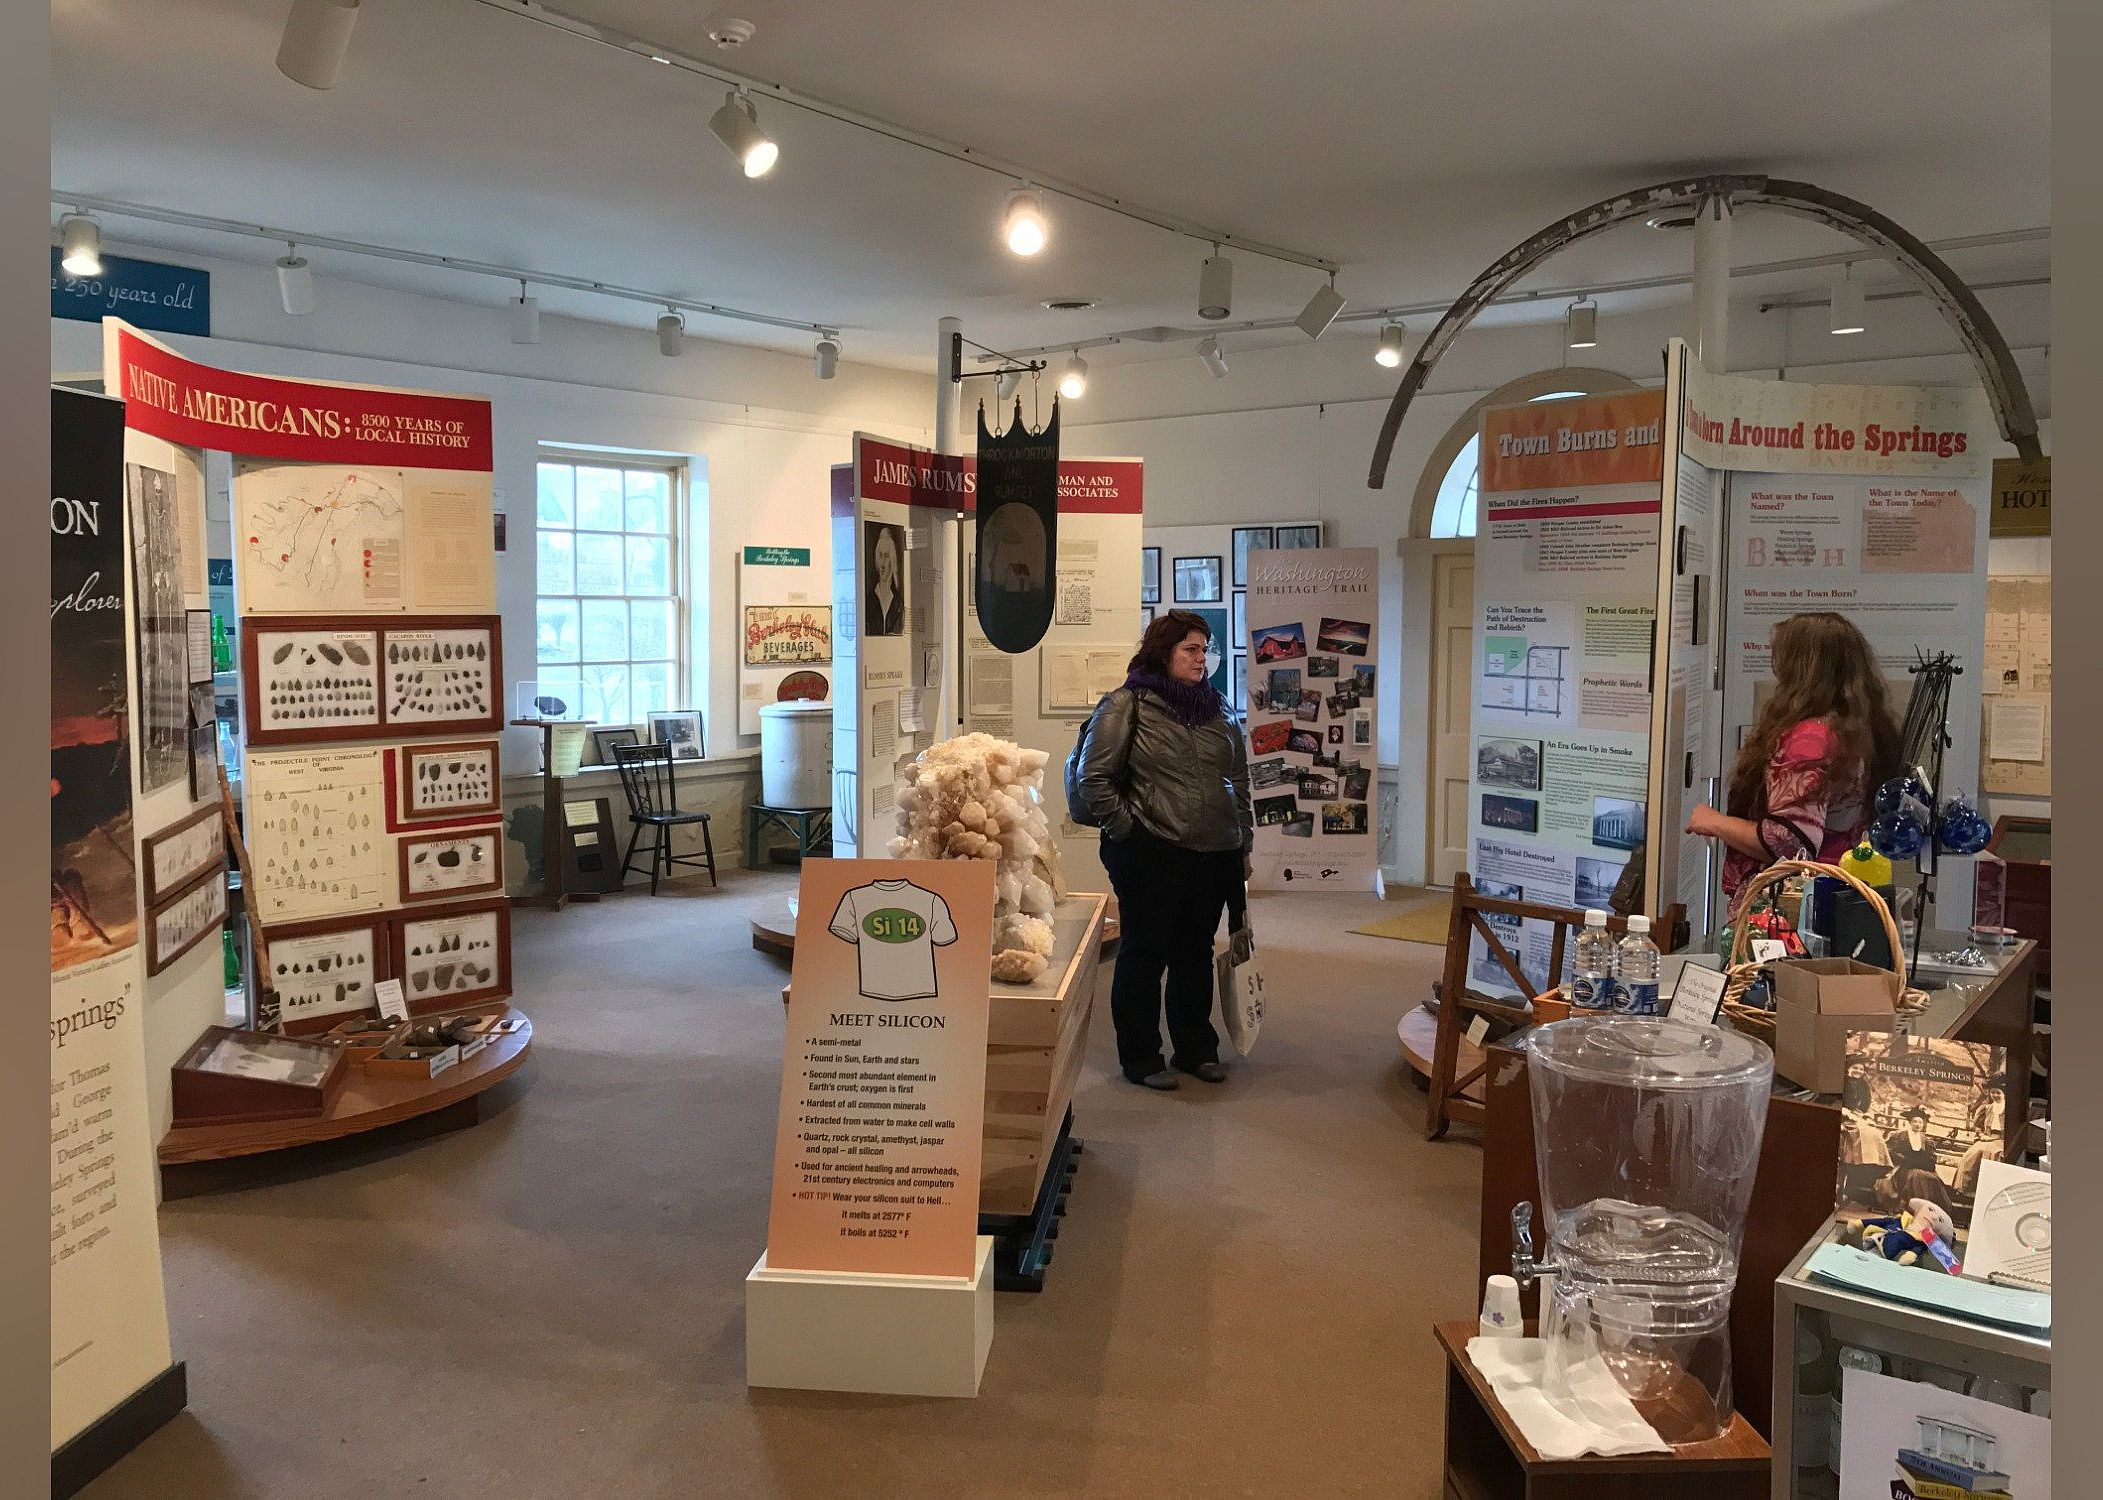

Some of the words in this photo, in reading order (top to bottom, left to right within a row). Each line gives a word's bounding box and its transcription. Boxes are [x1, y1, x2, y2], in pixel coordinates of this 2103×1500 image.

[64, 278, 102, 297] 250
[107, 285, 157, 308] years
[163, 282, 196, 309] old
[127, 363, 178, 415] NATIVE
[182, 388, 350, 439] AMERICANS:
[361, 413, 390, 428] 8500
[394, 415, 442, 432] YEARS
[446, 420, 465, 434] OF
[355, 427, 405, 444] LOCAL
[409, 432, 471, 448] HISTORY
[1500, 433, 1550, 458] Town
[1557, 428, 1617, 454] Burns
[1624, 417, 1661, 447] and
[1728, 417, 1805, 449] Around
[1814, 423, 1855, 451] the
[1864, 423, 1967, 458] Springs
[874, 458, 916, 488] JAMES
[1090, 476, 1113, 486] AND
[1056, 486, 1118, 498] SSOCIATES
[1751, 492, 1773, 501] What
[1797, 493, 1808, 501] the
[1811, 493, 1834, 501] Town
[1869, 488, 1892, 497] What
[1894, 489, 1902, 497] is
[1904, 489, 1917, 497] the
[1920, 489, 1945, 497] Name
[1948, 489, 1957, 497] of
[1550, 495, 1579, 504] Happen?
[1869, 499, 1883, 507] the
[1885, 499, 1909, 507] Town
[1910, 499, 1942, 509] Today?
[2001, 489, 2051, 508] HOT
[1750, 502, 1785, 511] Named?
[1255, 561, 1369, 592] Washington
[1256, 585, 1318, 595] HERITAGE
[1333, 584, 1369, 593] TRAIL
[1744, 589, 1768, 598] When
[1771, 590, 1788, 598] was
[1790, 589, 1803, 598] the
[1805, 589, 1829, 598] Town
[1831, 589, 1857, 599] Born?
[1486, 606, 1499, 614] Can
[1618, 607, 1638, 615] Great
[1486, 615, 1501, 623] Path
[1510, 615, 1546, 623] Destruction
[763, 642, 814, 653] BEVERAGES
[1742, 642, 1767, 651] Why
[1583, 678, 1618, 689] Prophetic
[1620, 680, 1642, 688] Words
[1558, 742, 1569, 750] Era
[1570, 743, 1587, 752] Goes
[1589, 744, 1599, 754] Up
[1601, 745, 1608, 753] in
[1609, 747, 1633, 756] Smoke
[1504, 847, 1522, 857] Hotel
[1523, 850, 1555, 863] Destroyed
[872, 917, 890, 936] Si
[898, 917, 920, 935] 14
[1504, 933, 1519, 943] 1912
[829, 1014, 874, 1027] MEET
[878, 1015, 946, 1029] SILICON
[811, 1038, 817, 1046] A
[819, 1039, 861, 1047] semi-metal
[810, 1054, 834, 1062] Found
[844, 1055, 861, 1064] Sun,
[863, 1055, 882, 1063] Earth
[885, 1056, 898, 1064] and
[900, 1056, 919, 1065] stars
[809, 1071, 836, 1079] Second
[839, 1072, 857, 1080] most
[860, 1072, 895, 1081] abundant
[896, 1073, 927, 1081] element
[929, 1074, 936, 1082] in
[1879, 1062, 1925, 1076] BERKELEY
[1929, 1068, 1971, 1081] SPRINGS
[809, 1083, 835, 1091] Earth's
[837, 1084, 858, 1092] crust;
[861, 1084, 887, 1094] oxygen
[889, 1085, 896, 1093] is
[898, 1085, 913, 1094] first
[807, 1099, 836, 1107] Hardest
[838, 1100, 845, 1108] of
[893, 1102, 926, 1110] minerals
[804, 1133, 831, 1142] Quartz,
[832, 1134, 849, 1142] rock
[851, 1134, 879, 1144] crystal,
[881, 1135, 919, 1145] amethyst,
[920, 1136, 944, 1147] jaspar
[822, 1146, 838, 1155] opal
[859, 1147, 884, 1155] silicon
[801, 1162, 820, 1170] Used
[822, 1162, 833, 1171] for
[835, 1163, 863, 1172] ancient
[865, 1164, 893, 1174] healing
[895, 1166, 909, 1174] and
[911, 1167, 959, 1176] arrowheads,
[803, 1175, 820, 1183] 21st
[821, 1176, 851, 1185] century
[853, 1177, 895, 1186] electronics
[897, 1178, 911, 1187] and
[913, 1179, 954, 1188] computers
[799, 1191, 815, 1199] HOT
[833, 1193, 851, 1201] Wear
[854, 1194, 871, 1203] your
[873, 1194, 898, 1203] silicon
[900, 1195, 915, 1204] suit
[917, 1196, 925, 1205] to
